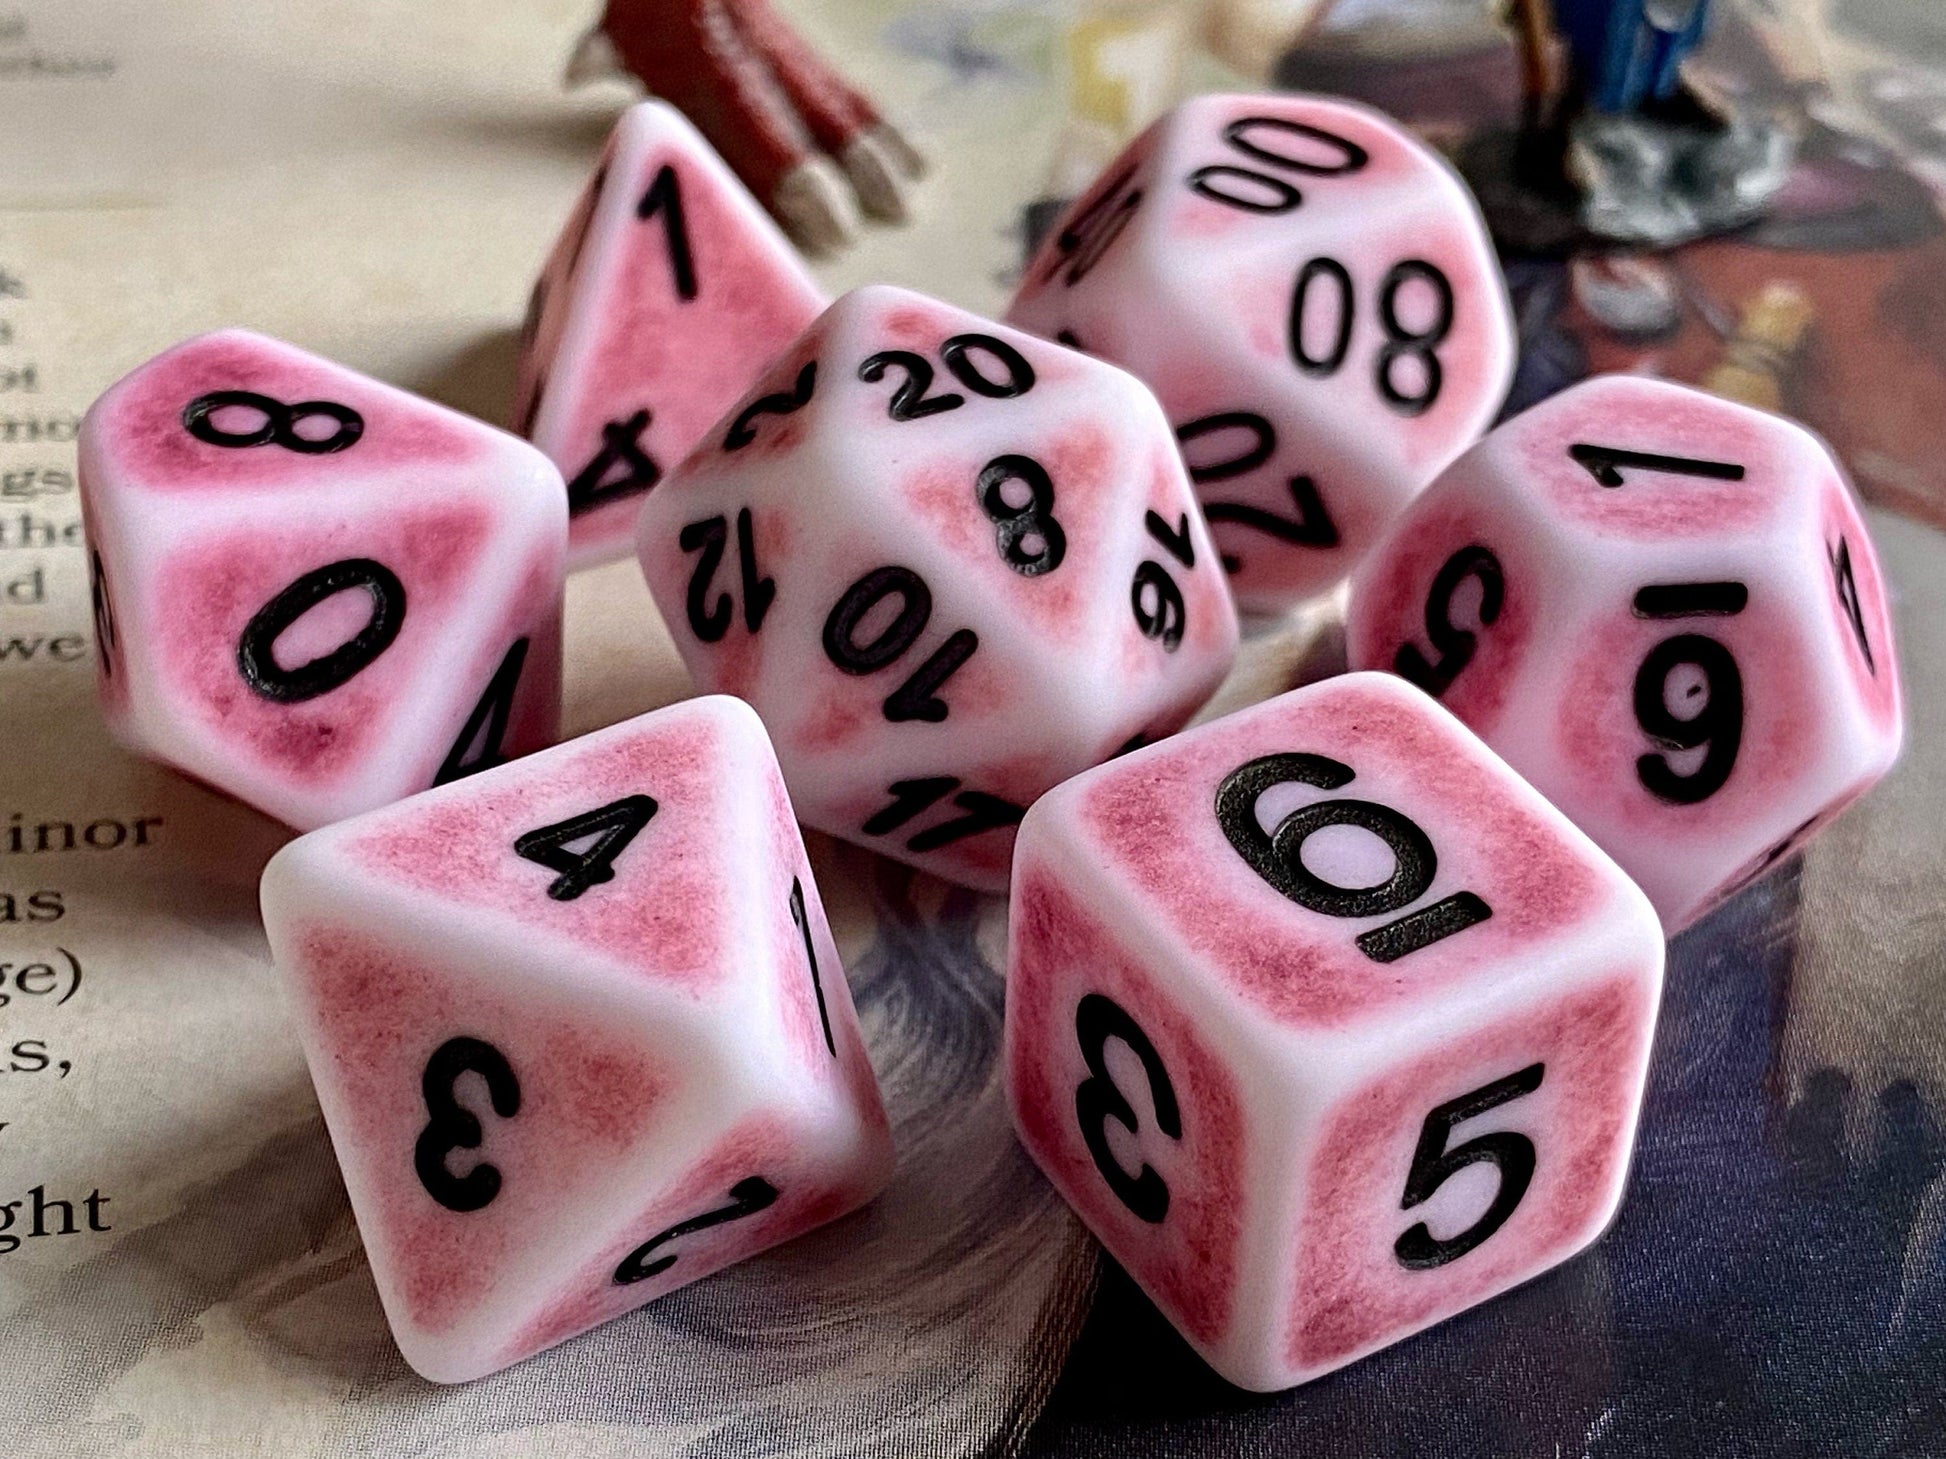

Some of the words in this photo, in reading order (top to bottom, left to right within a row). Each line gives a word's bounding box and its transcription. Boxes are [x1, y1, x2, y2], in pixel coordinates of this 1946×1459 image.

[637, 164, 698, 303] 1
[1184, 115, 1370, 215] 00
[182, 390, 365, 455] 8
[857, 332, 1037, 422] 20
[568, 408, 663, 518] 4
[976, 453, 1067, 578] 8
[1567, 443, 1746, 488] 1
[238, 557, 408, 705] 0
[679, 506, 777, 644] 12
[821, 564, 980, 724] 10
[1131, 509, 1196, 653] 16
[1394, 544, 1506, 698] 5
[430, 635, 531, 789] 4
[7, 812, 163, 854] inor
[513, 794, 659, 902] 4
[1214, 750, 1495, 965] 6
[788, 874, 838, 1058] 1
[414, 1034, 522, 1214] 3
[1074, 992, 1183, 1225] 3
[1393, 1061, 1547, 1271] 5
[613, 1174, 778, 1287] 2
